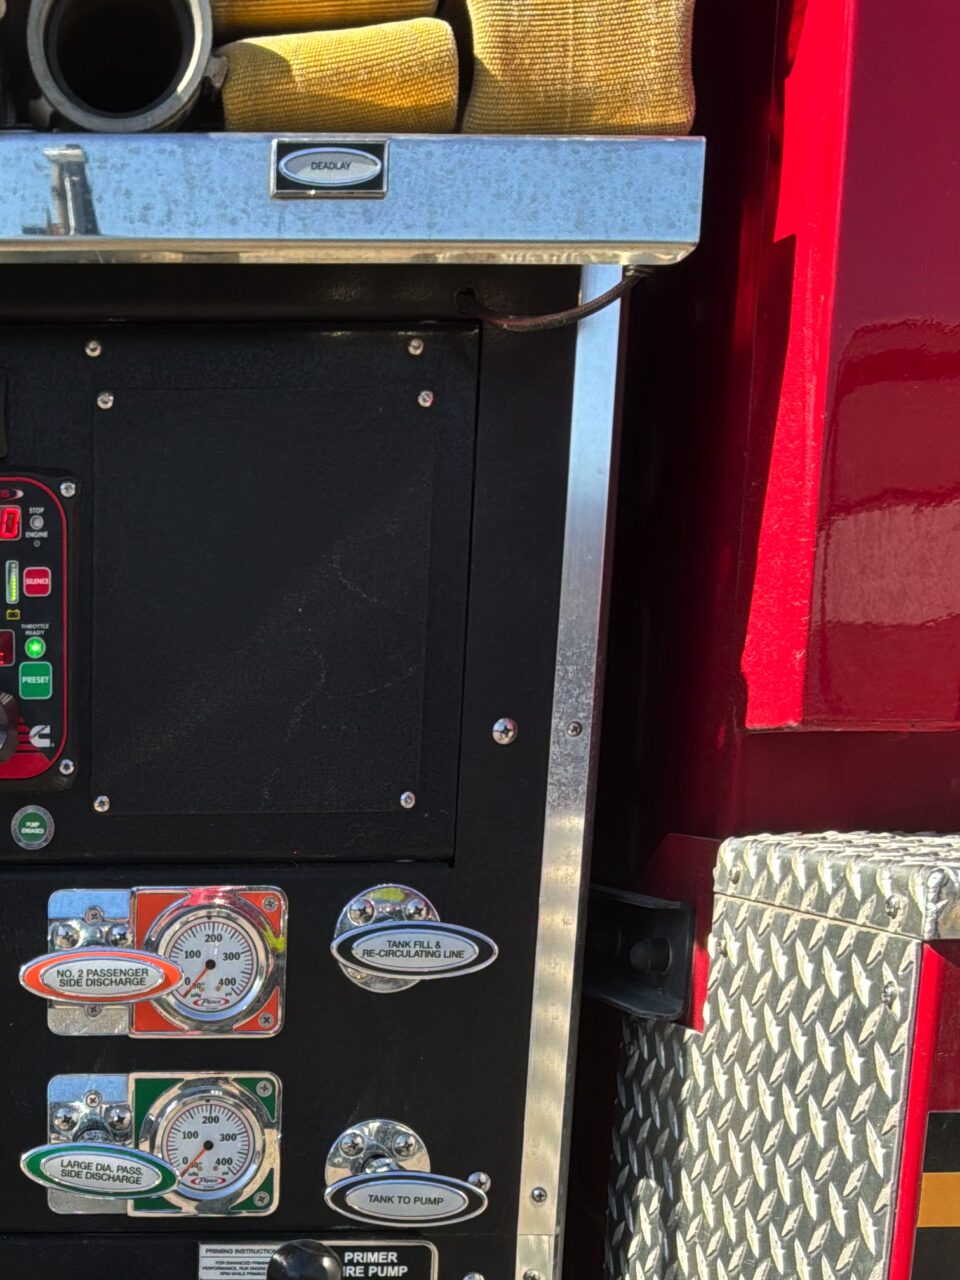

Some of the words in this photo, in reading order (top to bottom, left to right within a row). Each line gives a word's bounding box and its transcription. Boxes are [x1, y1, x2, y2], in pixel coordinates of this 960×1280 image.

[311, 162, 351, 170] DEADLAY
[22, 675, 49, 684] PRESET
[204, 934, 222, 943] 200
[387, 940, 412, 948] TANK
[414, 941, 432, 949] FILL
[435, 941, 441, 949] &
[184, 950, 201, 960] 100
[222, 952, 240, 961] 300
[362, 950, 441, 958] RE-CIRCULATING
[444, 950, 465, 958] LINE
[56, 969, 76, 978] NO.
[78, 970, 84, 978] 2
[86, 968, 149, 978] PASSENGER
[59, 978, 83, 988] SIDE
[85, 977, 146, 987] DISCHARGE
[218, 978, 236, 987] 400
[201, 1116, 220, 1124] 200
[182, 1130, 199, 1140] 100
[219, 1133, 237, 1142] 300
[215, 1157, 233, 1166] 400
[60, 1159, 94, 1171] LARGE
[95, 1162, 114, 1172] DIA.
[117, 1164, 144, 1176] PASS.
[60, 1169, 84, 1180] SIDE
[85, 1171, 143, 1185] DISCHARGE
[368, 1195, 396, 1203] TANK
[398, 1196, 411, 1204] TO
[414, 1197, 444, 1206] PUMP
[344, 1252, 398, 1263] PRIMER
[342, 1267, 364, 1277] IRE
[368, 1266, 408, 1277] PUMP
